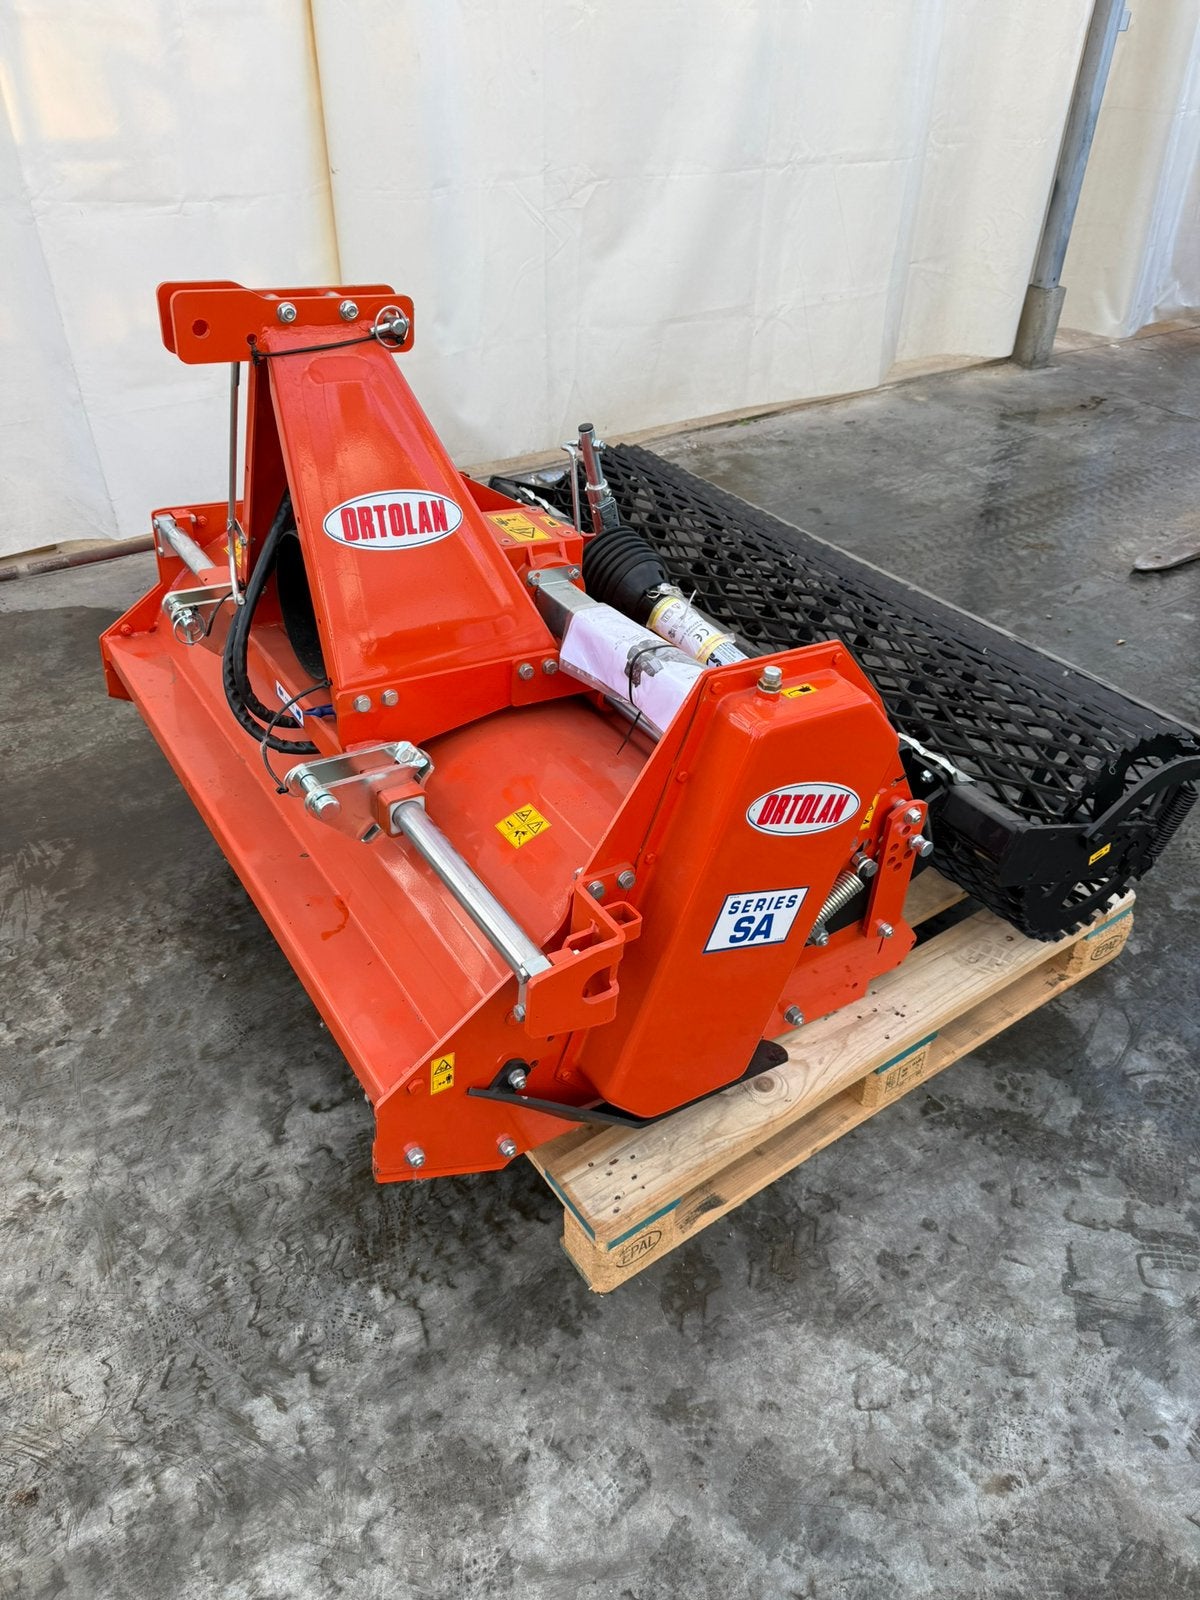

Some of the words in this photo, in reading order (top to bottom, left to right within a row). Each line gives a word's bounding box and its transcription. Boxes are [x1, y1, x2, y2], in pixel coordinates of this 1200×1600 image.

[340, 499, 449, 542] ORTOLAN
[756, 793, 851, 828] ORTOLAN
[728, 894, 799, 915] SERIES
[728, 913, 775, 944] SA
[621, 1236, 656, 1264] EPAL
